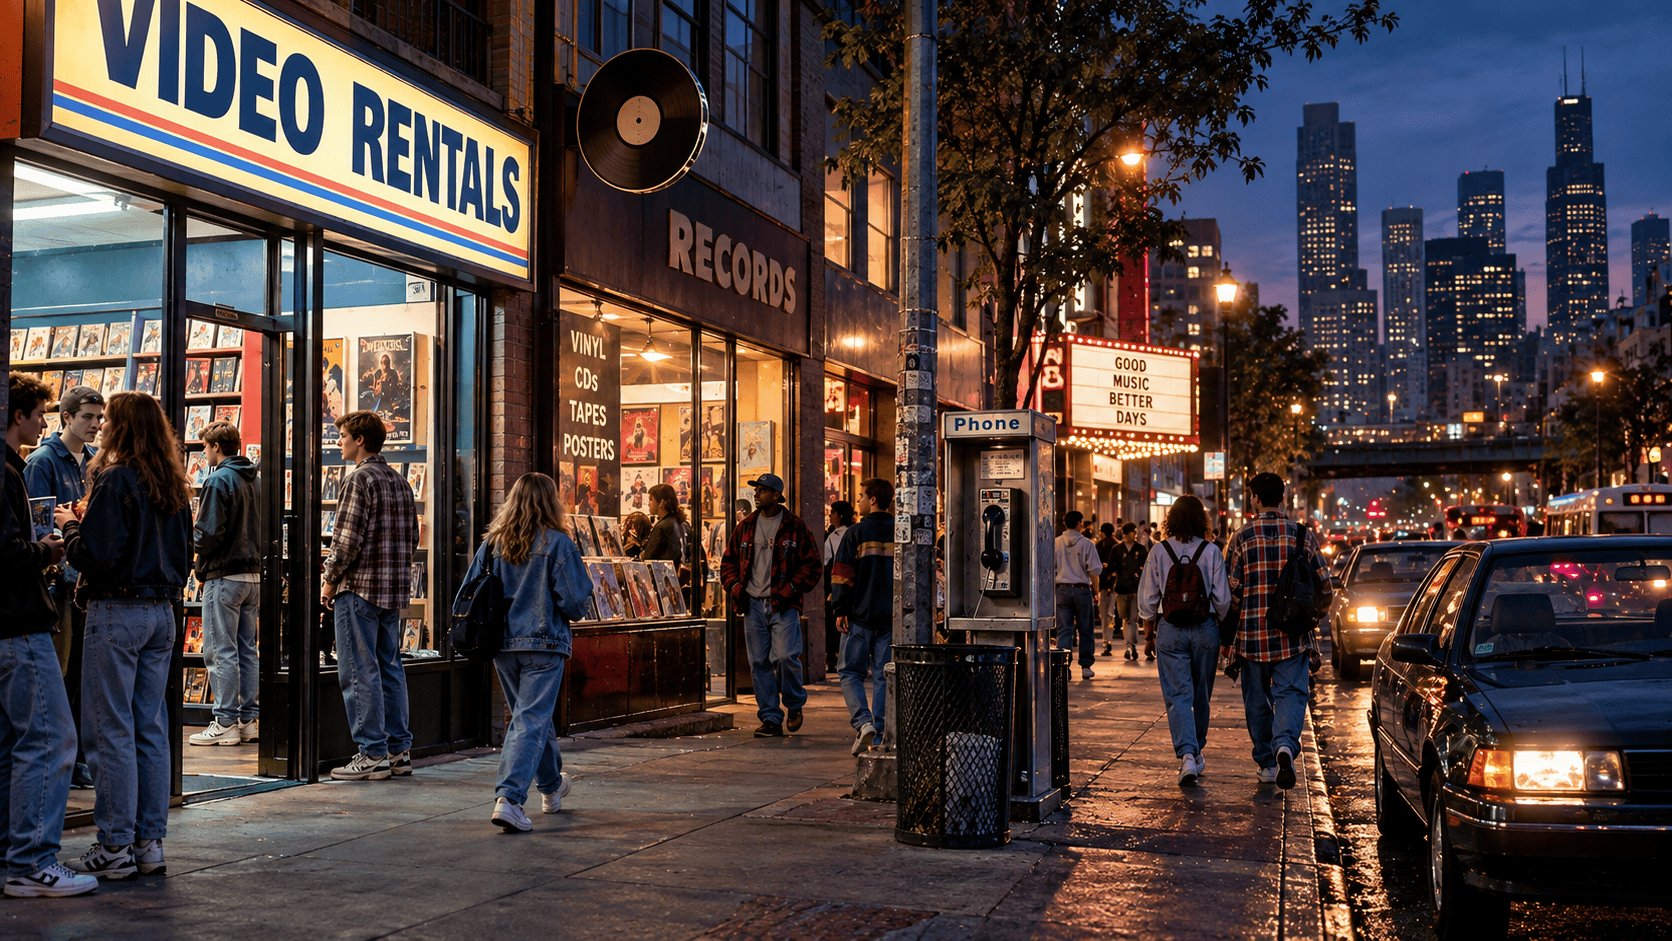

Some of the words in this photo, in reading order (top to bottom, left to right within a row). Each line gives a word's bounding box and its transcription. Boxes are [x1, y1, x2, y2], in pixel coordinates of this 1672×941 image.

[98, 0, 324, 155] VIDEO
[352, 81, 520, 233] RENTALS
[668, 208, 796, 314] RECORDS
[571, 330, 606, 360] VINYL
[1115, 357, 1147, 372] GOOD
[574, 366, 598, 392] CDs
[1113, 374, 1150, 391] MUSIC
[569, 400, 607, 426] TAPES
[1109, 392, 1153, 409] BETTER
[954, 417, 1020, 431] Phone
[1116, 410, 1147, 425] DAYS
[564, 433, 615, 461] POSTERS
